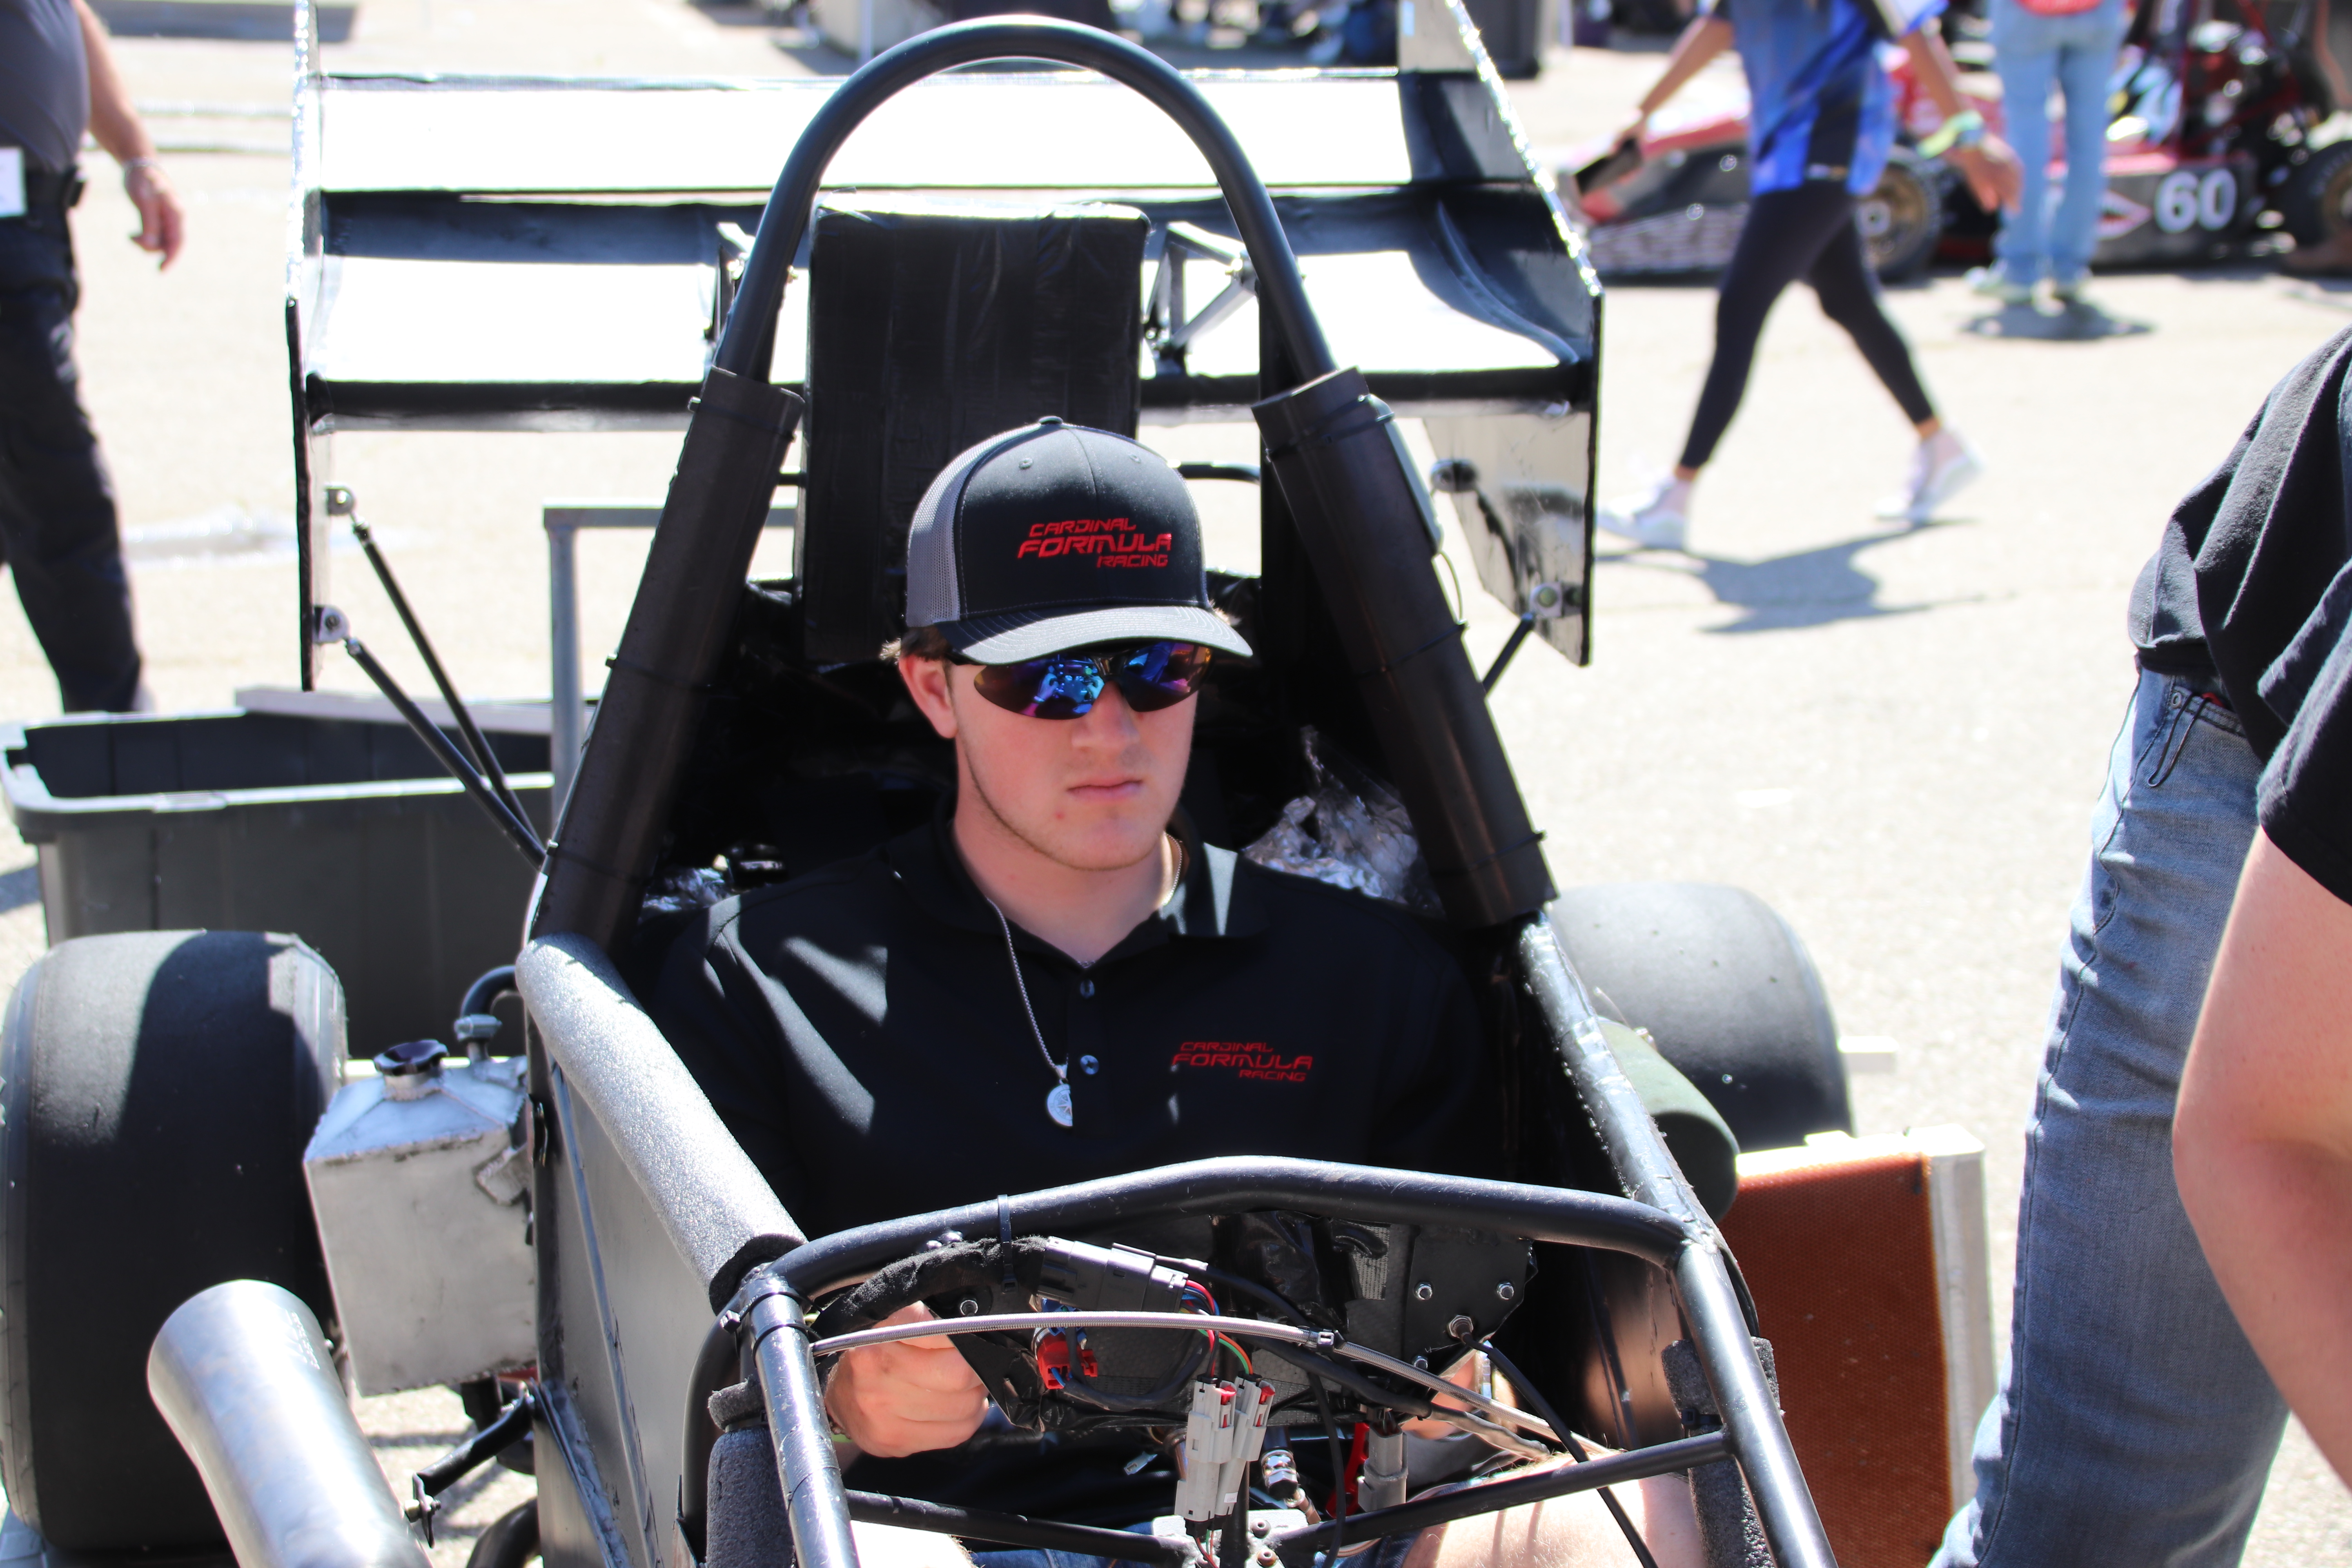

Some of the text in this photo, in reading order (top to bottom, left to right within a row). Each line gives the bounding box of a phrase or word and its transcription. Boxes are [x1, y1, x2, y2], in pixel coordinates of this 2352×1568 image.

[2155, 168, 2237, 233] 60
[1028, 518, 1137, 537] CARDINAL
[1017, 533, 1172, 559] FORMULA
[1097, 554, 1169, 568] RACING
[1180, 1042, 1274, 1052] CARDINAL
[1171, 1053, 1313, 1070] FORMULA
[1239, 1069, 1306, 1082] RACING
